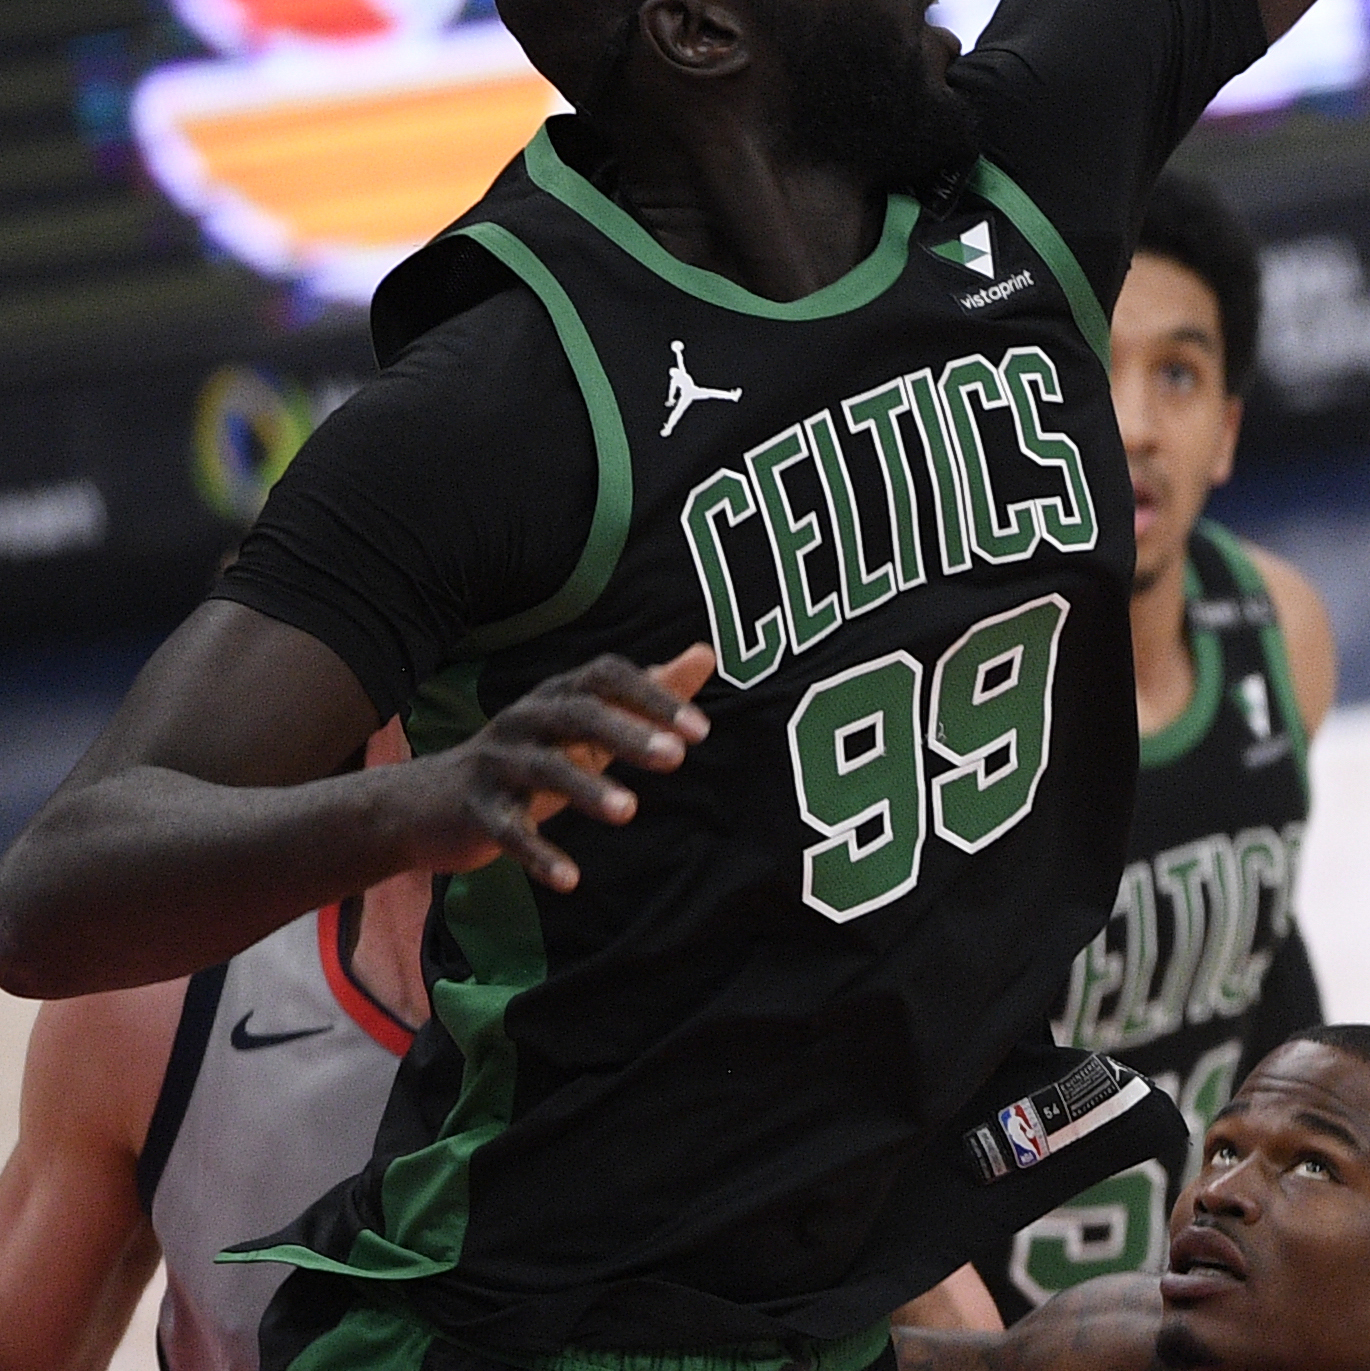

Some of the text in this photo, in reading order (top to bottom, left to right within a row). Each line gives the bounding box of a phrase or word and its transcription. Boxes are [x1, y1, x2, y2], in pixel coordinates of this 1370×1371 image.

[960, 269, 1035, 310] vistaprint
[681, 345, 1099, 690] CELTICS
[787, 593, 1071, 924] 99
[1050, 820, 1306, 1054] ELTIC
